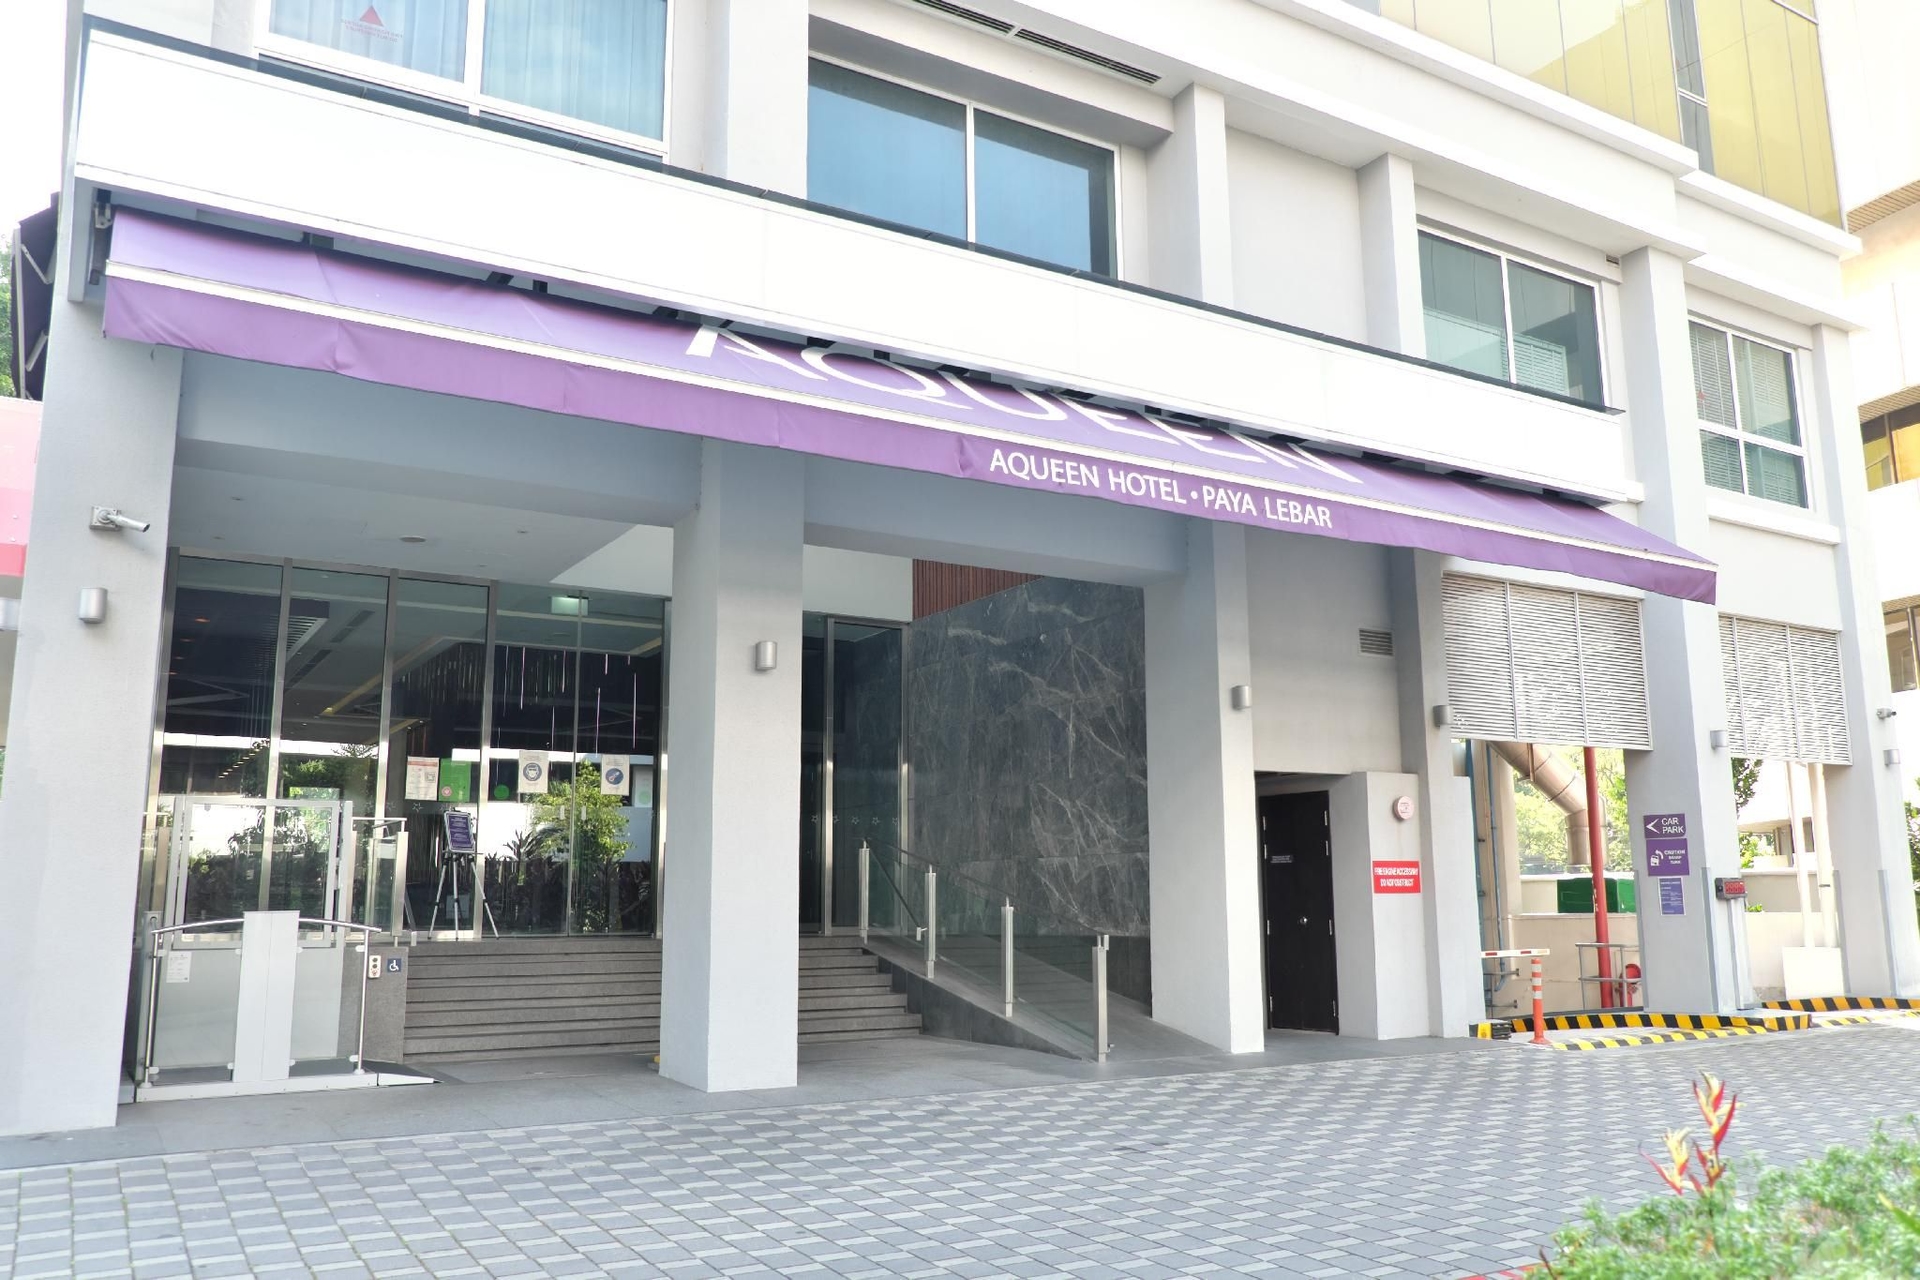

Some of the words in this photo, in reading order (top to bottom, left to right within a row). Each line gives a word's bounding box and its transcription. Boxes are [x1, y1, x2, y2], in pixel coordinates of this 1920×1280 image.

[685, 324, 1364, 485] AQUEEN
[989, 448, 1101, 488] AQUEEN
[1108, 468, 1187, 505] HOTEL
[1203, 484, 1258, 517] PAYA
[1264, 496, 1333, 529] LEBAR
[1661, 817, 1679, 826] CAR
[1662, 825, 1684, 834] PARK
